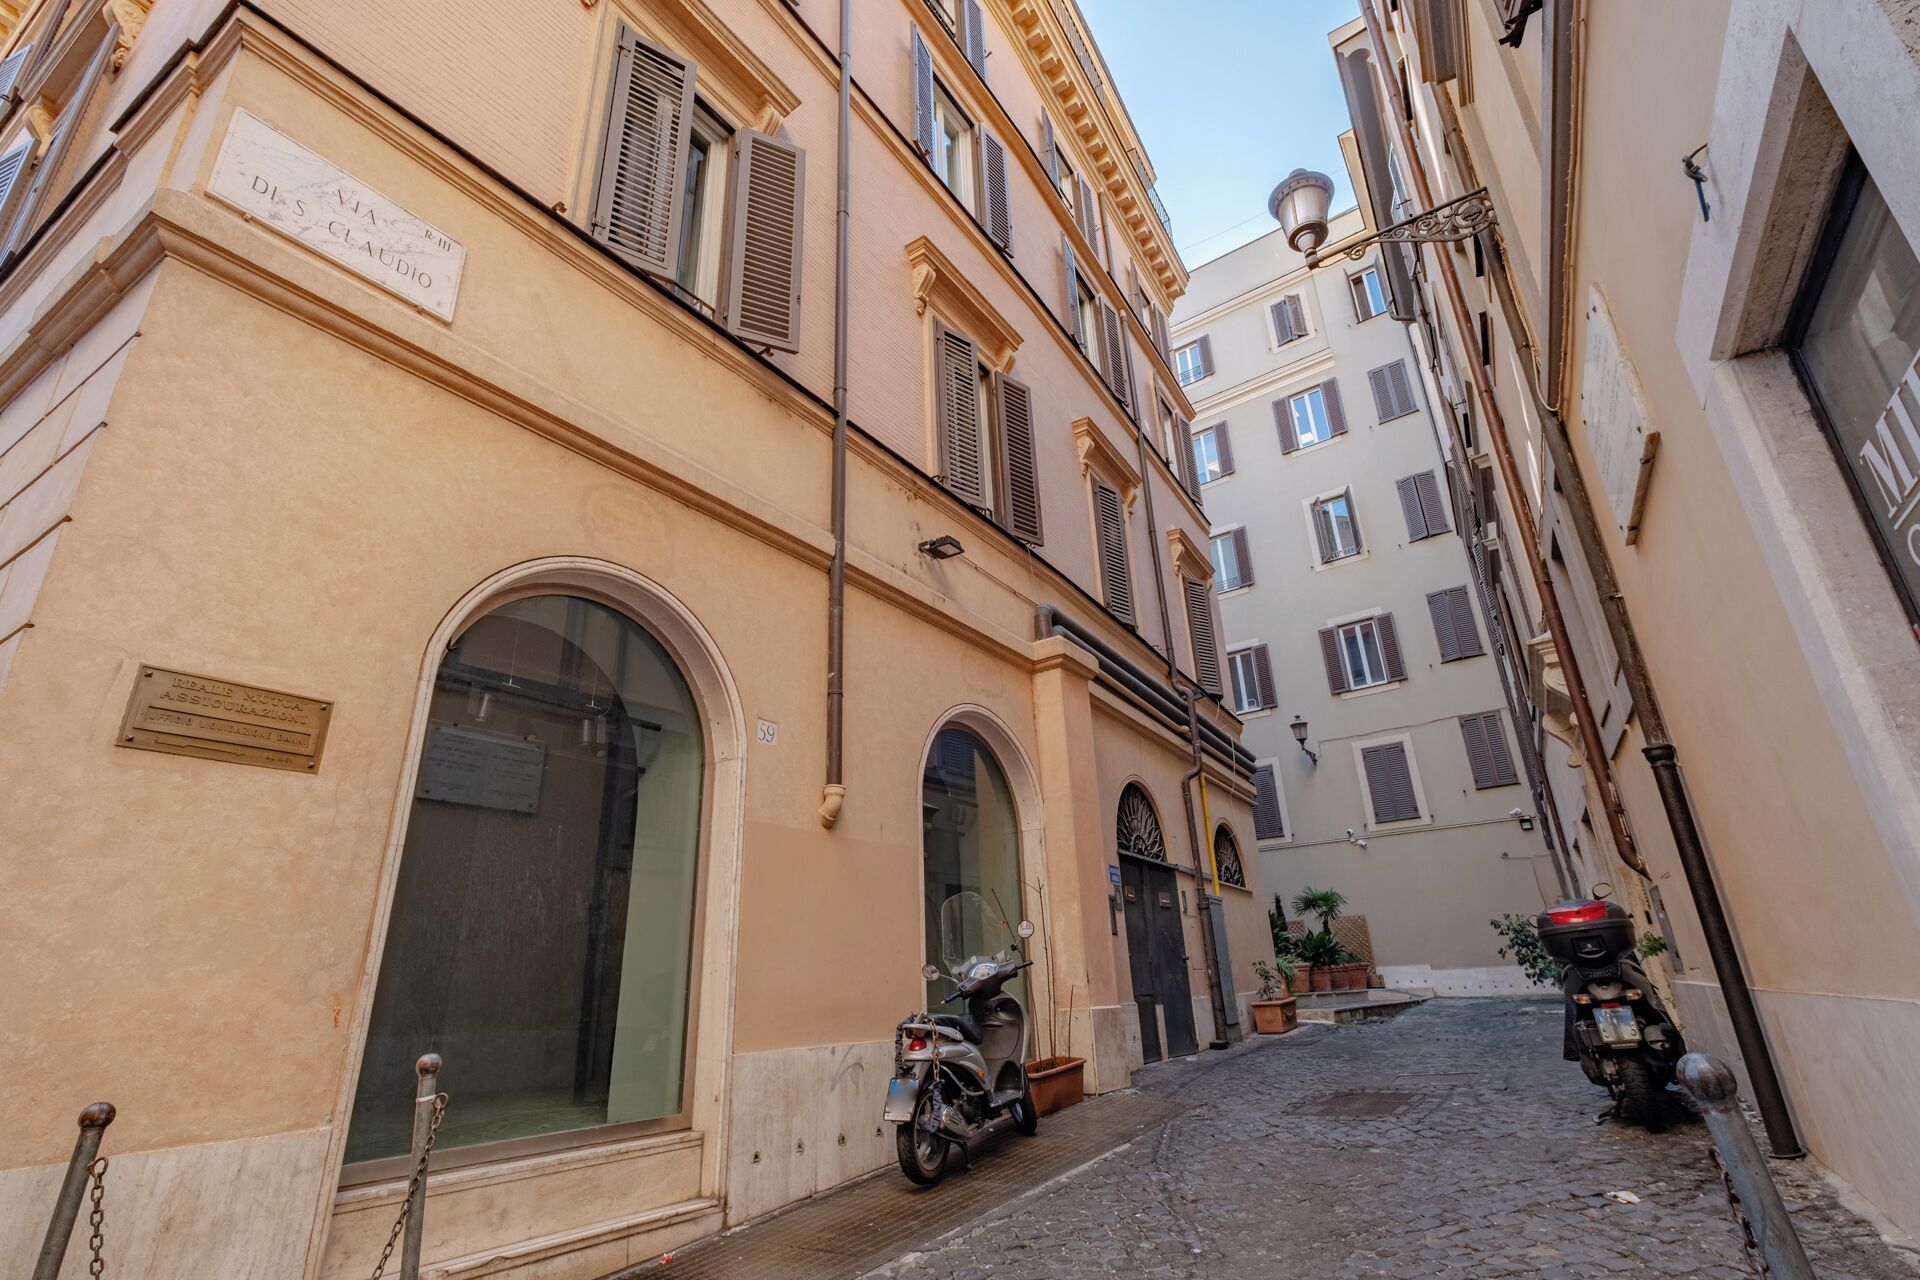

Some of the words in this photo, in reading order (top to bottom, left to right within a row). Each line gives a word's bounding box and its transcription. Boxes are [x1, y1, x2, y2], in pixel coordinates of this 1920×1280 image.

[337, 189, 376, 225] VIA
[251, 175, 277, 201] DI
[293, 200, 306, 217] S
[328, 221, 431, 288] CLAUDIO
[425, 229, 433, 240] R
[438, 238, 451, 252] III
[160, 692, 308, 725] ASSICURAZIONI
[172, 678, 233, 697] REALE
[243, 691, 303, 711] MUTUA
[148, 711, 193, 727] UFFICIO
[199, 719, 272, 741] LIQUIDAZIONE
[758, 722, 775, 743] 59
